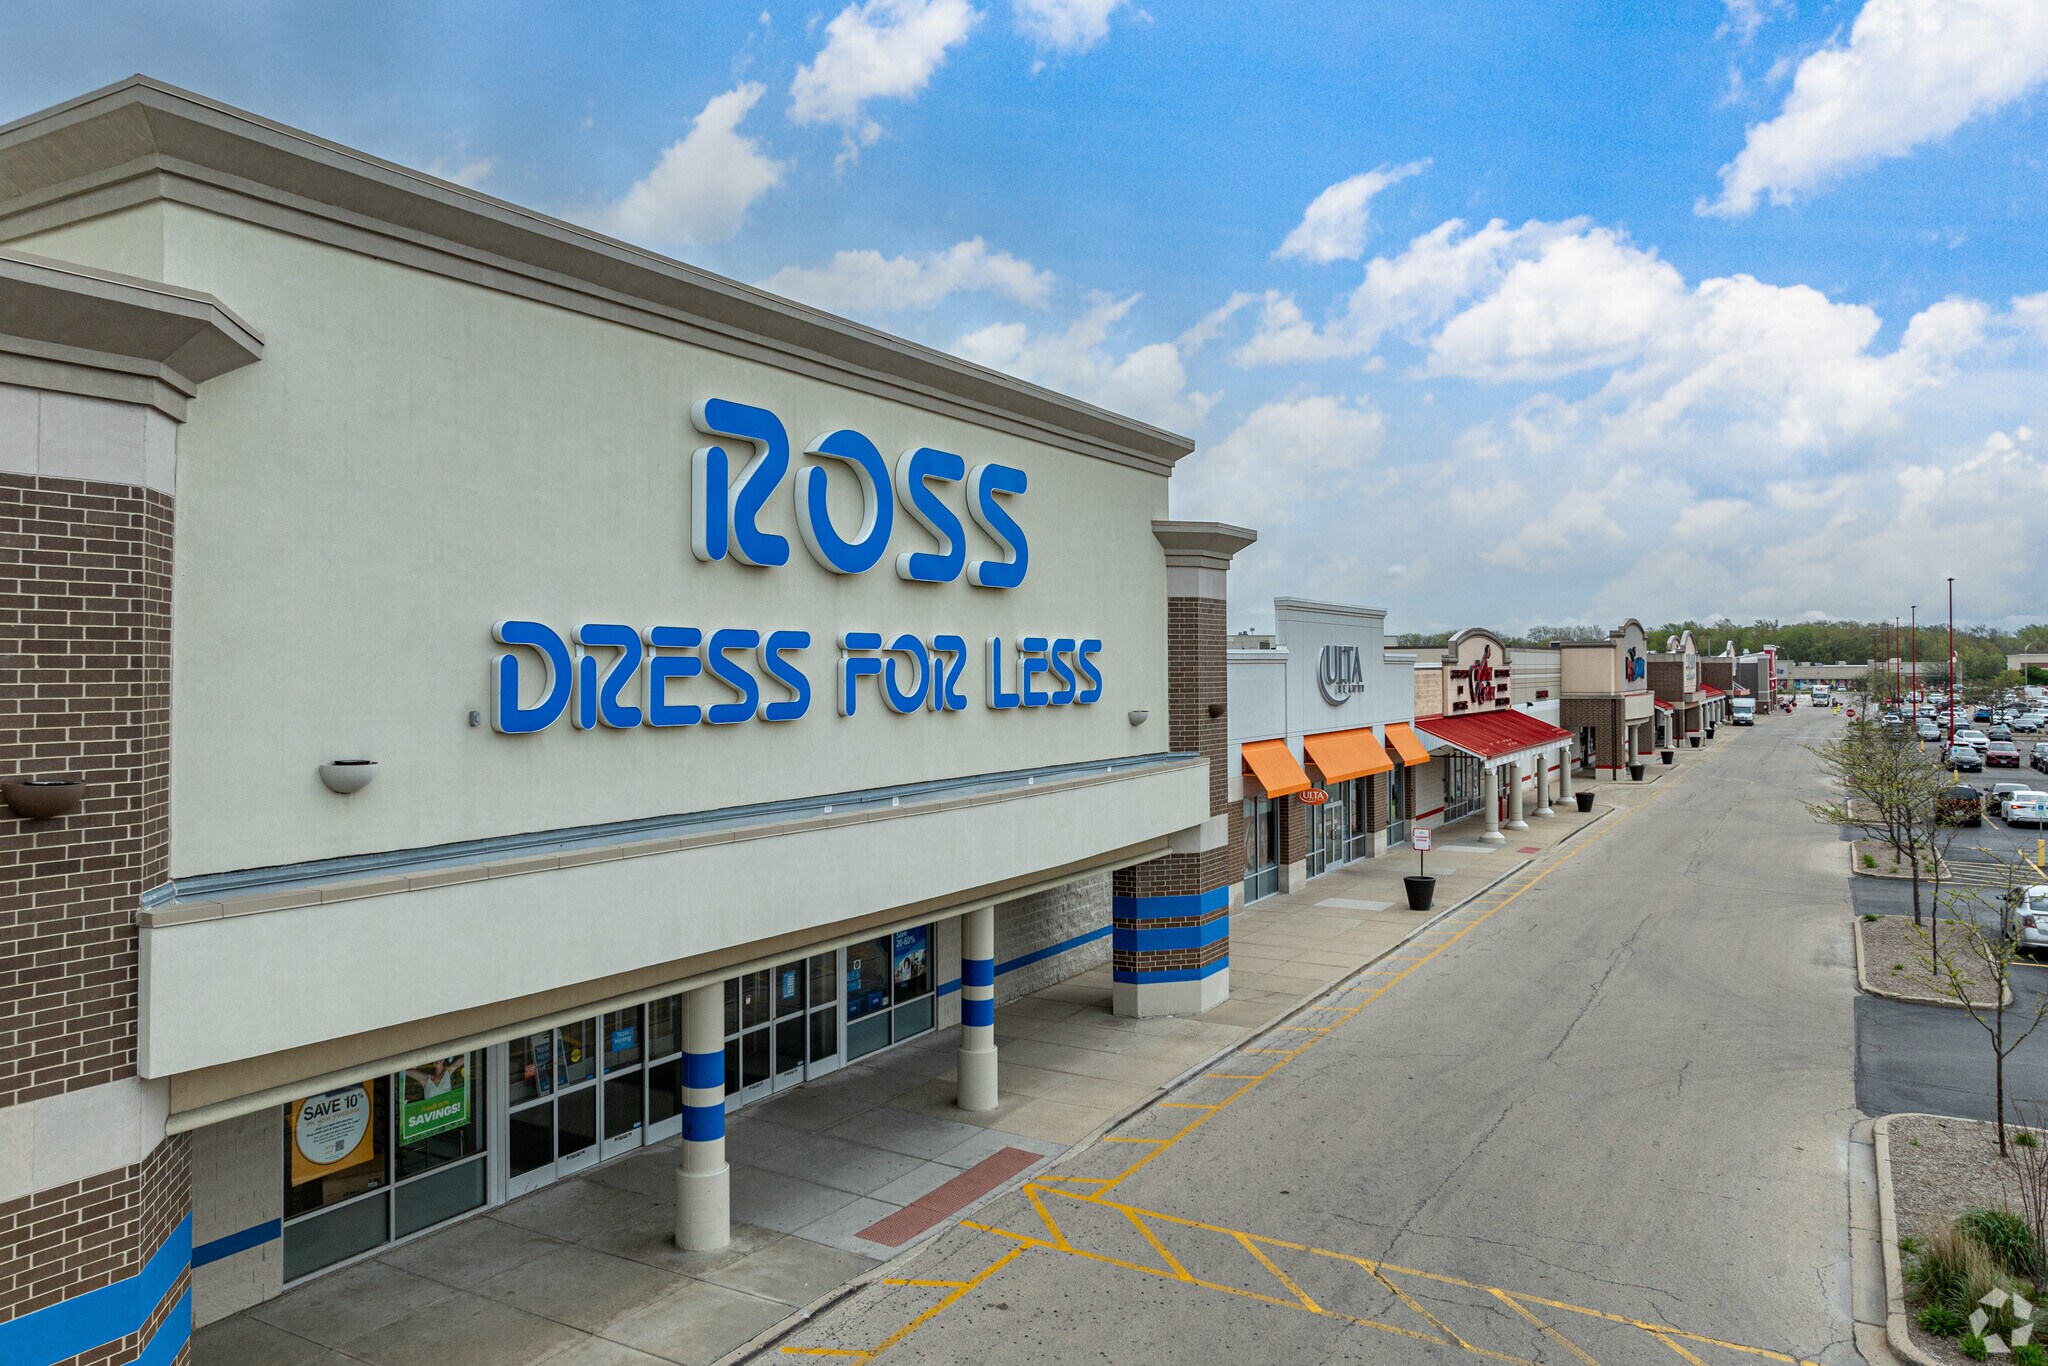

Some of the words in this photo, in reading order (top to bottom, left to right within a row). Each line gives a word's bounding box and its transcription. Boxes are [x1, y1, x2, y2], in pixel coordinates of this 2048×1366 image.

[691, 397, 1029, 589] ROSS
[491, 620, 811, 734] DRESS
[837, 632, 967, 717] FOR
[986, 636, 1103, 710] LESS
[1323, 645, 1363, 684] ULTA
[1302, 791, 1324, 800] ULTA
[615, 1035, 631, 1045] Hiring
[617, 1030, 629, 1038] Now
[304, 1098, 341, 1121] SAVE
[344, 1092, 364, 1109] 10%
[408, 1102, 461, 1127] SAVINGS!
